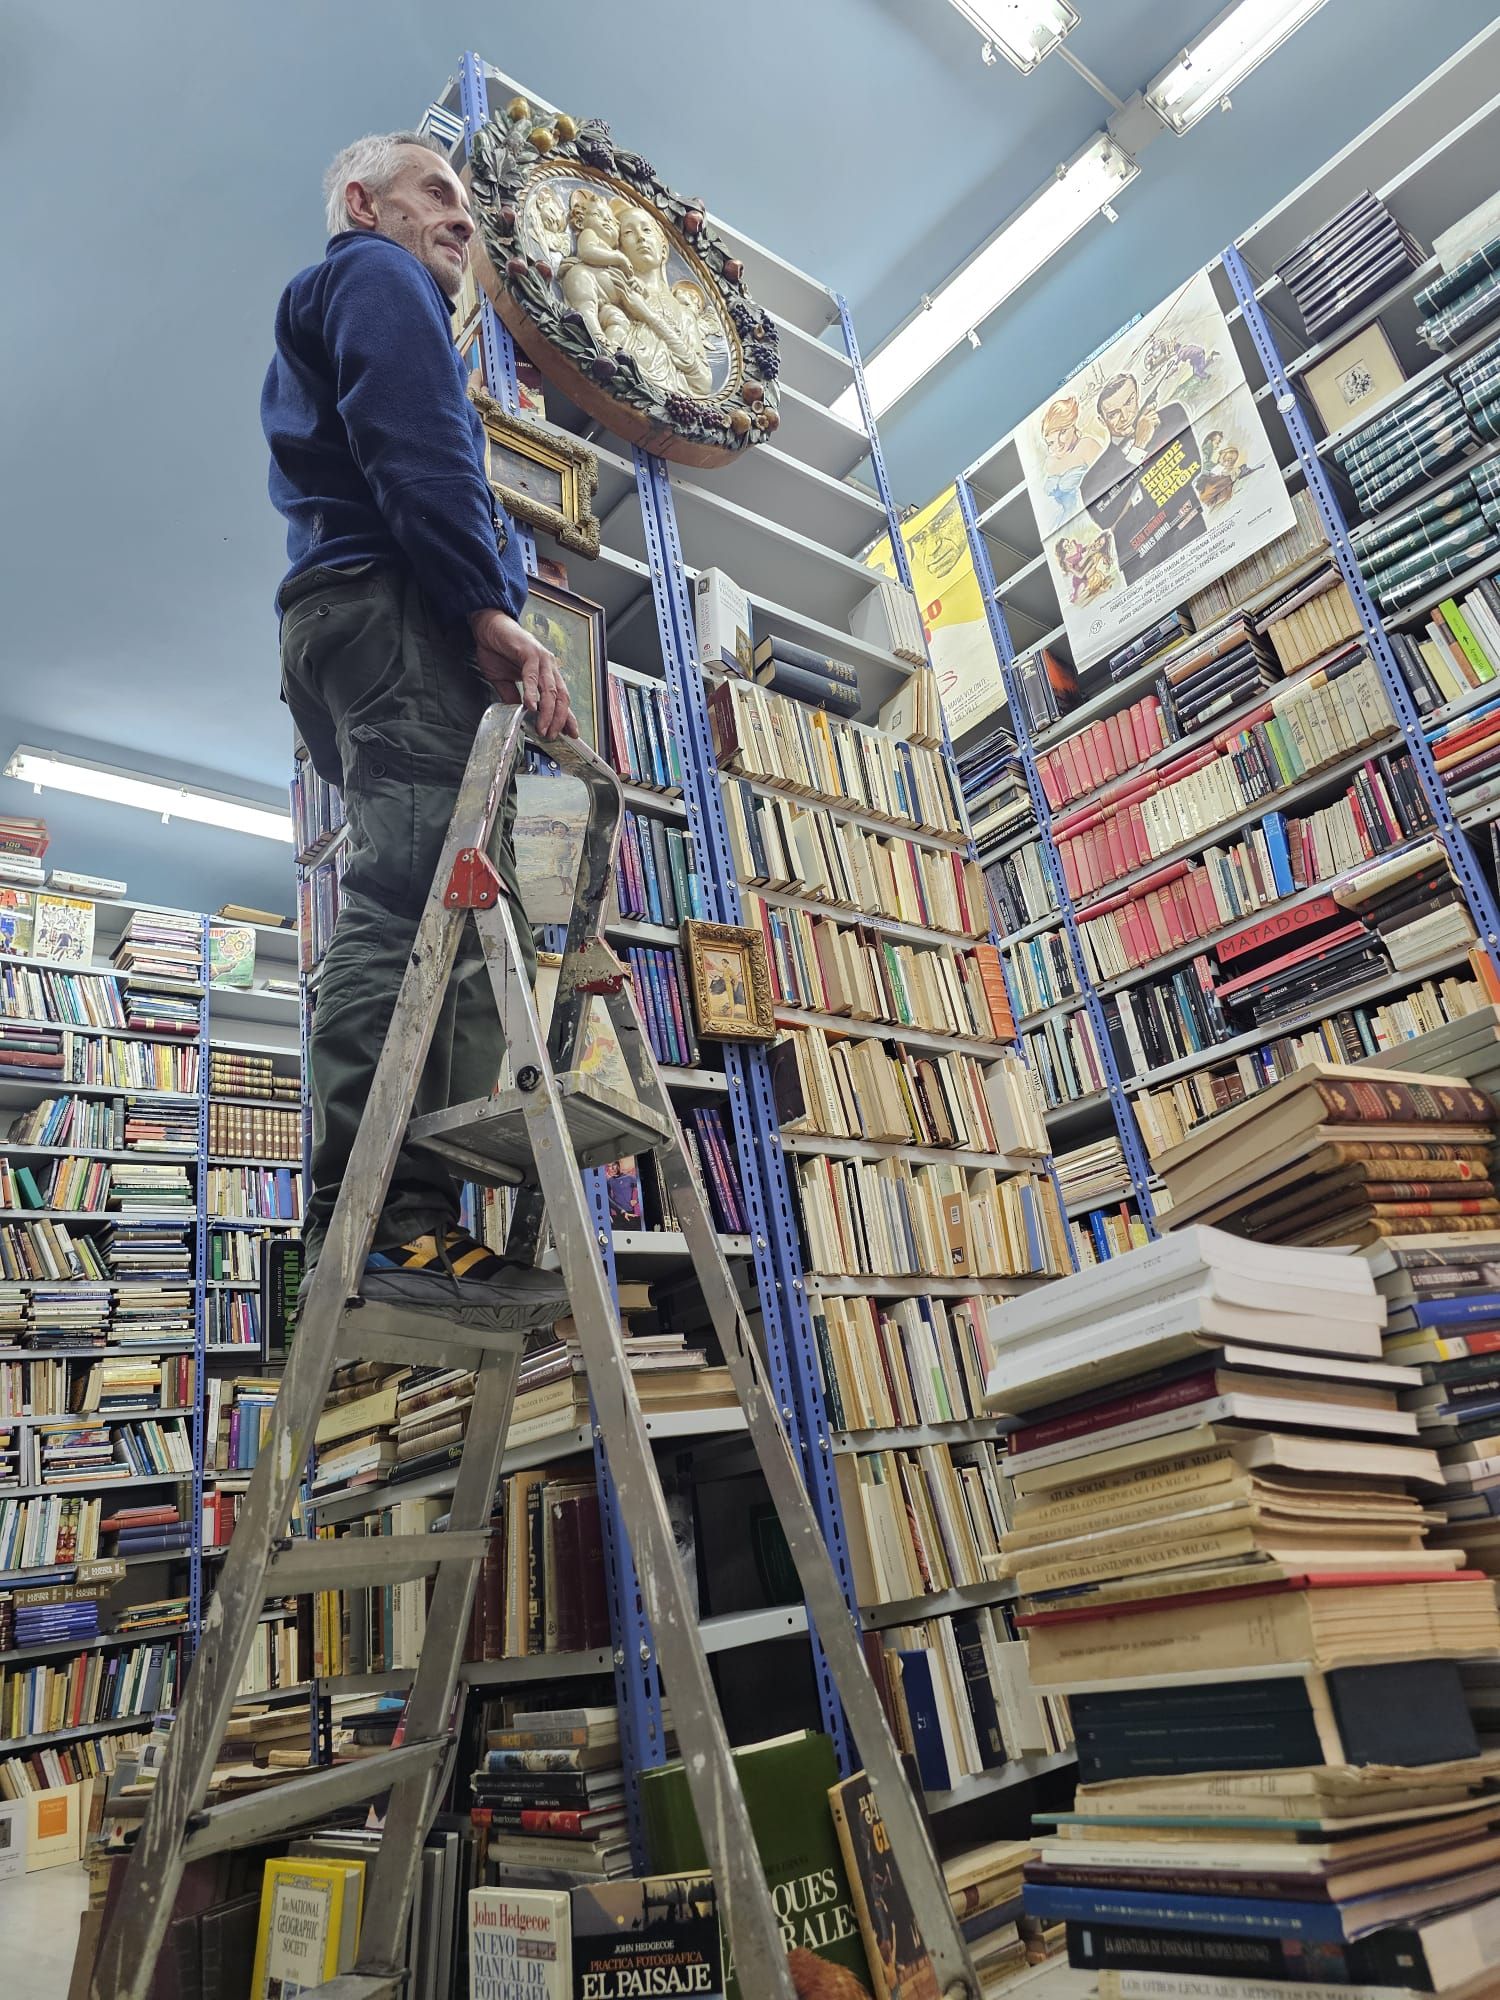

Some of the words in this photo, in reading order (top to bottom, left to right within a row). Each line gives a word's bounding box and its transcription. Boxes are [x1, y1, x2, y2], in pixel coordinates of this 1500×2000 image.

[1140, 440, 1182, 486] DESDE
[1145, 450, 1186, 493] RUSIA
[1151, 465, 1184, 500] CON
[1156, 461, 1200, 508] AMOR
[1138, 536, 1158, 558] JAMES
[1156, 522, 1172, 542] BOND
[1220, 903, 1326, 957] MATADOR
[1264, 986, 1288, 1000] MATADOR
[1050, 1490, 1074, 1502] ATLAS
[1077, 1480, 1107, 1496] SOCIAL
[1174, 1459, 1186, 1472] DE
[1056, 1566, 1091, 1580] PINTURA
[1091, 1551, 1166, 1574] CONTEMPORANEA
[1166, 1549, 1180, 1559] EN
[1181, 1540, 1221, 1556] MALAGA
[290, 1898, 319, 1918] NATIONAL
[772, 1868, 838, 1924] QUES
[277, 1914, 319, 1940] GEOGRAPHIC
[473, 1902, 497, 1928] John
[500, 1904, 550, 1936] Hedgecoe
[282, 1938, 308, 1957] SOCIETY
[474, 1932, 515, 1956] NUEVO
[614, 1942, 634, 1954] JOHN
[635, 1940, 674, 1951] HEDGECOE
[474, 1954, 526, 1983] MANUAL
[527, 1962, 545, 1984] DE
[590, 1956, 634, 1972] PRACTICA
[636, 1952, 704, 1968] FOTOGRAFICA
[582, 1972, 613, 2000] EL
[616, 1963, 712, 1999] PAISAJE
[1122, 1978, 1140, 1991] LOS
[1143, 1979, 1176, 1993] OTROS
